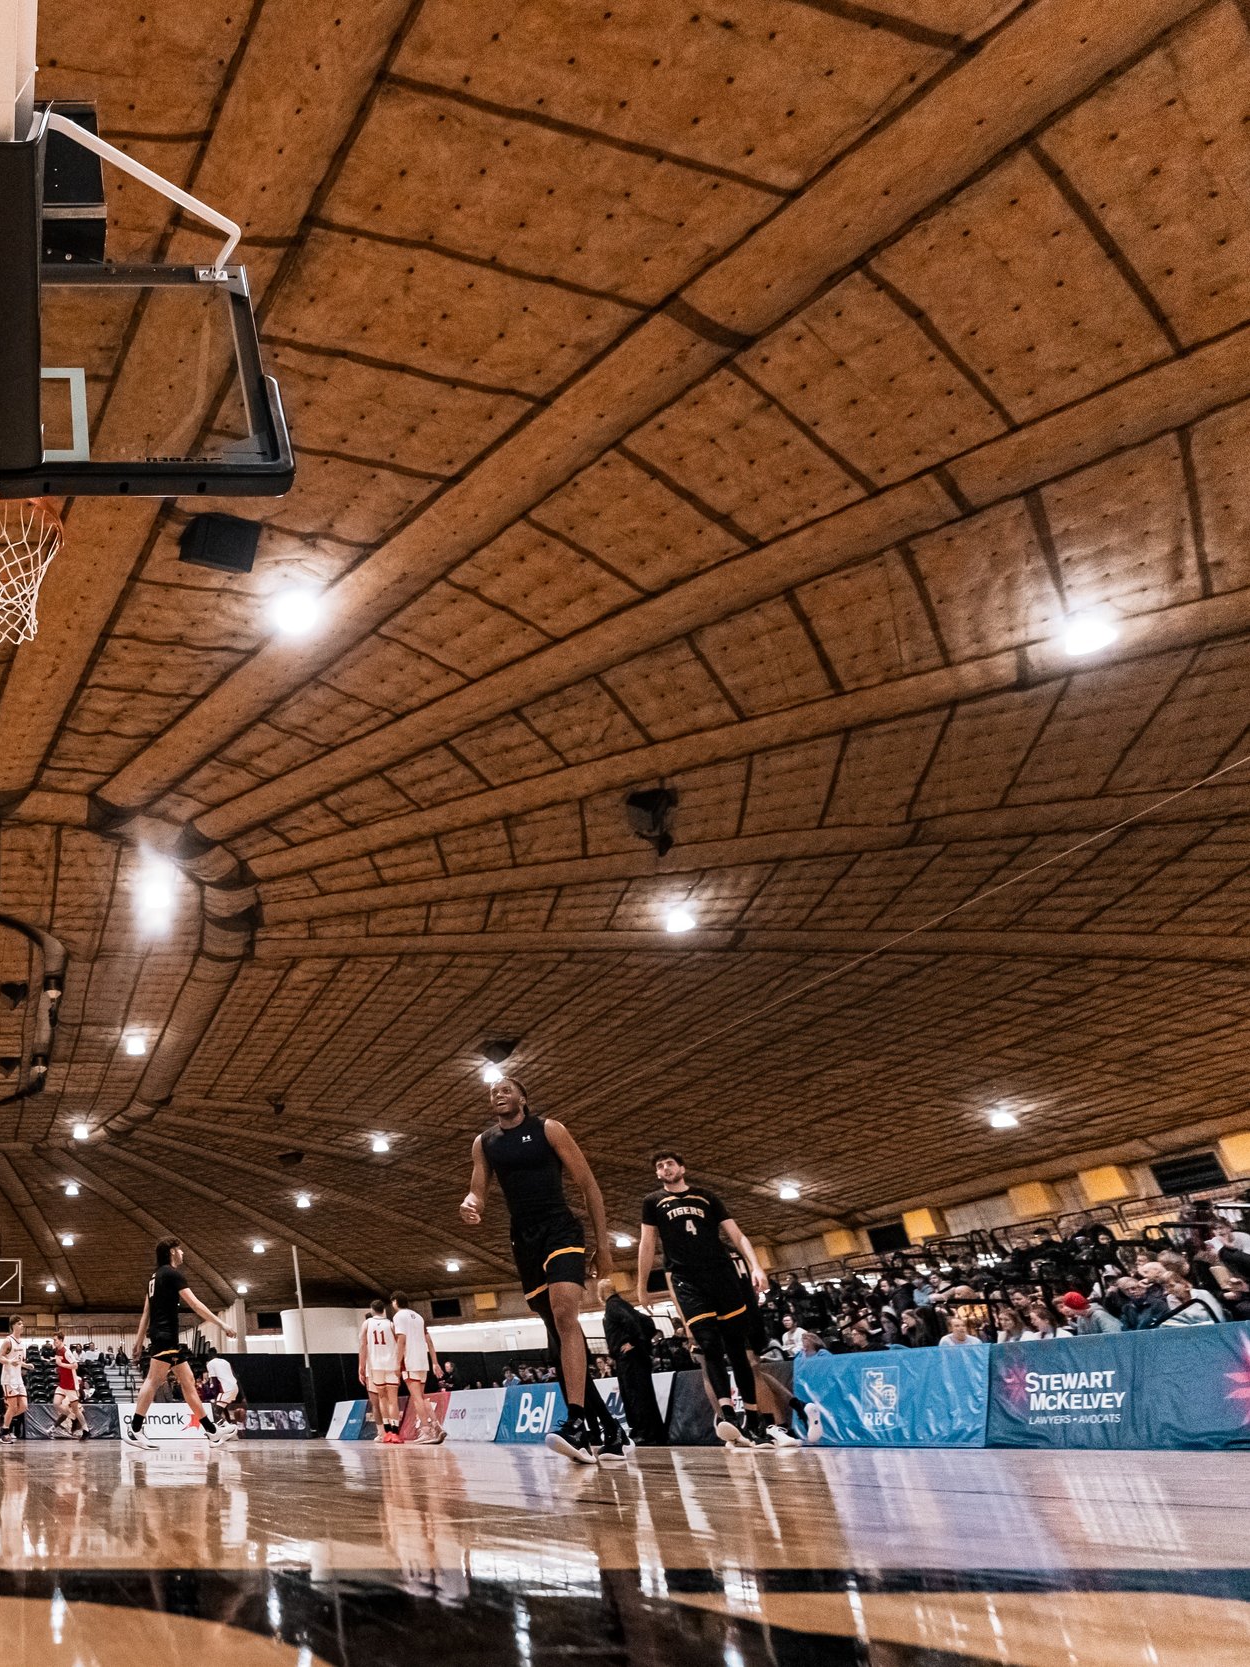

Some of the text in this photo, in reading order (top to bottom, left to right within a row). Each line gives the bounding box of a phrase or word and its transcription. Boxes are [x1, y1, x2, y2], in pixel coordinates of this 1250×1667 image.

[666, 1206, 705, 1221] TIGERS
[685, 1219, 697, 1236] 4
[373, 1329, 387, 1345] 11
[1024, 1370, 1116, 1393] STEWART
[515, 1391, 556, 1434] Bell
[862, 1412, 896, 1427] RBC
[1028, 1413, 1122, 1426] LAWYERS AVOCATS
